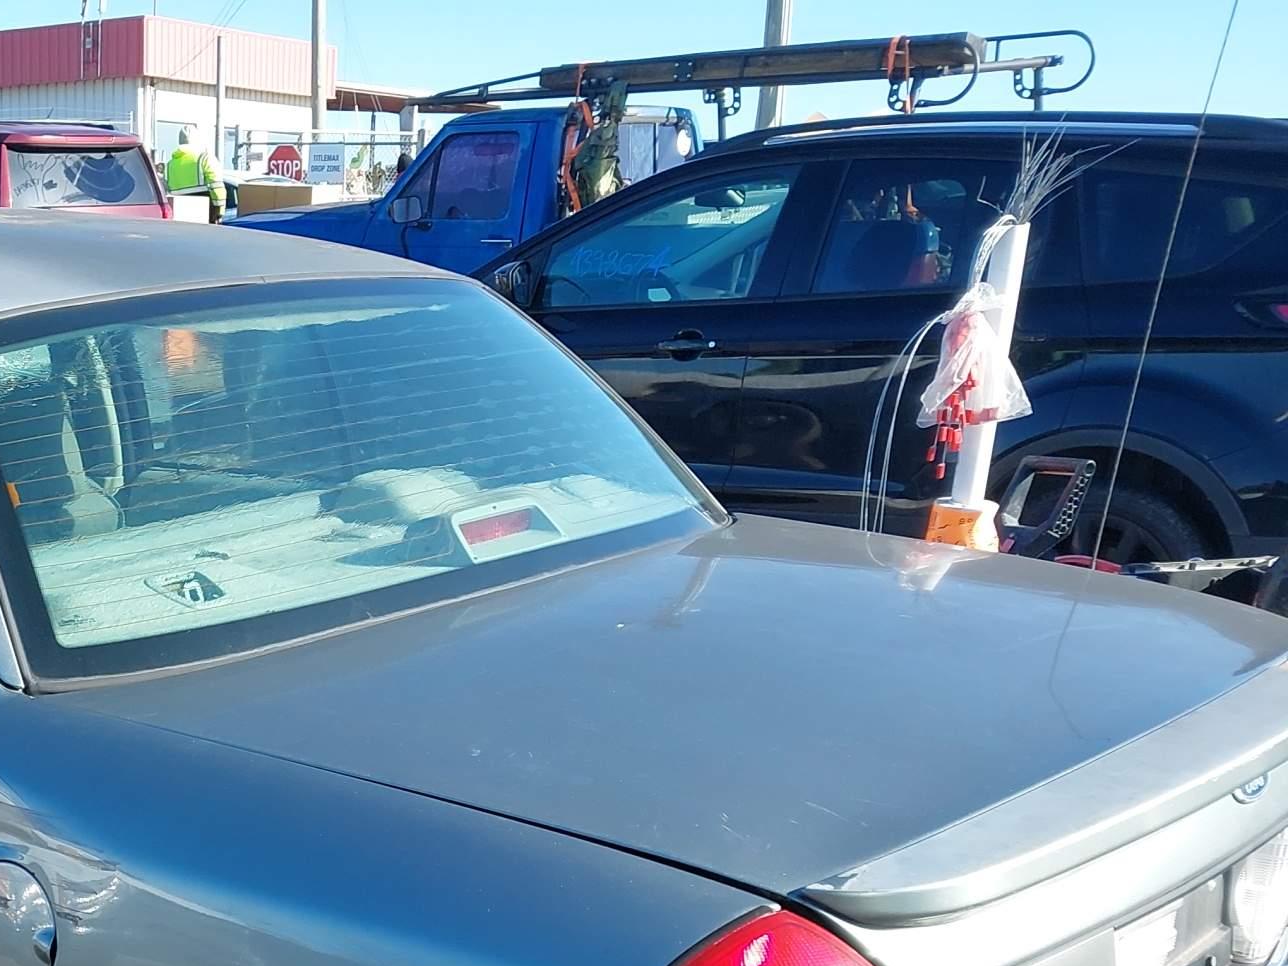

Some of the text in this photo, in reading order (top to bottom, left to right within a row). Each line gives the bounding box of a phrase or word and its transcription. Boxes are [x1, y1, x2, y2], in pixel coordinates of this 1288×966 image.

[313, 154, 339, 162] TITLEMAX
[270, 160, 301, 178] STOP
[311, 165, 341, 173] DROP ZONE
